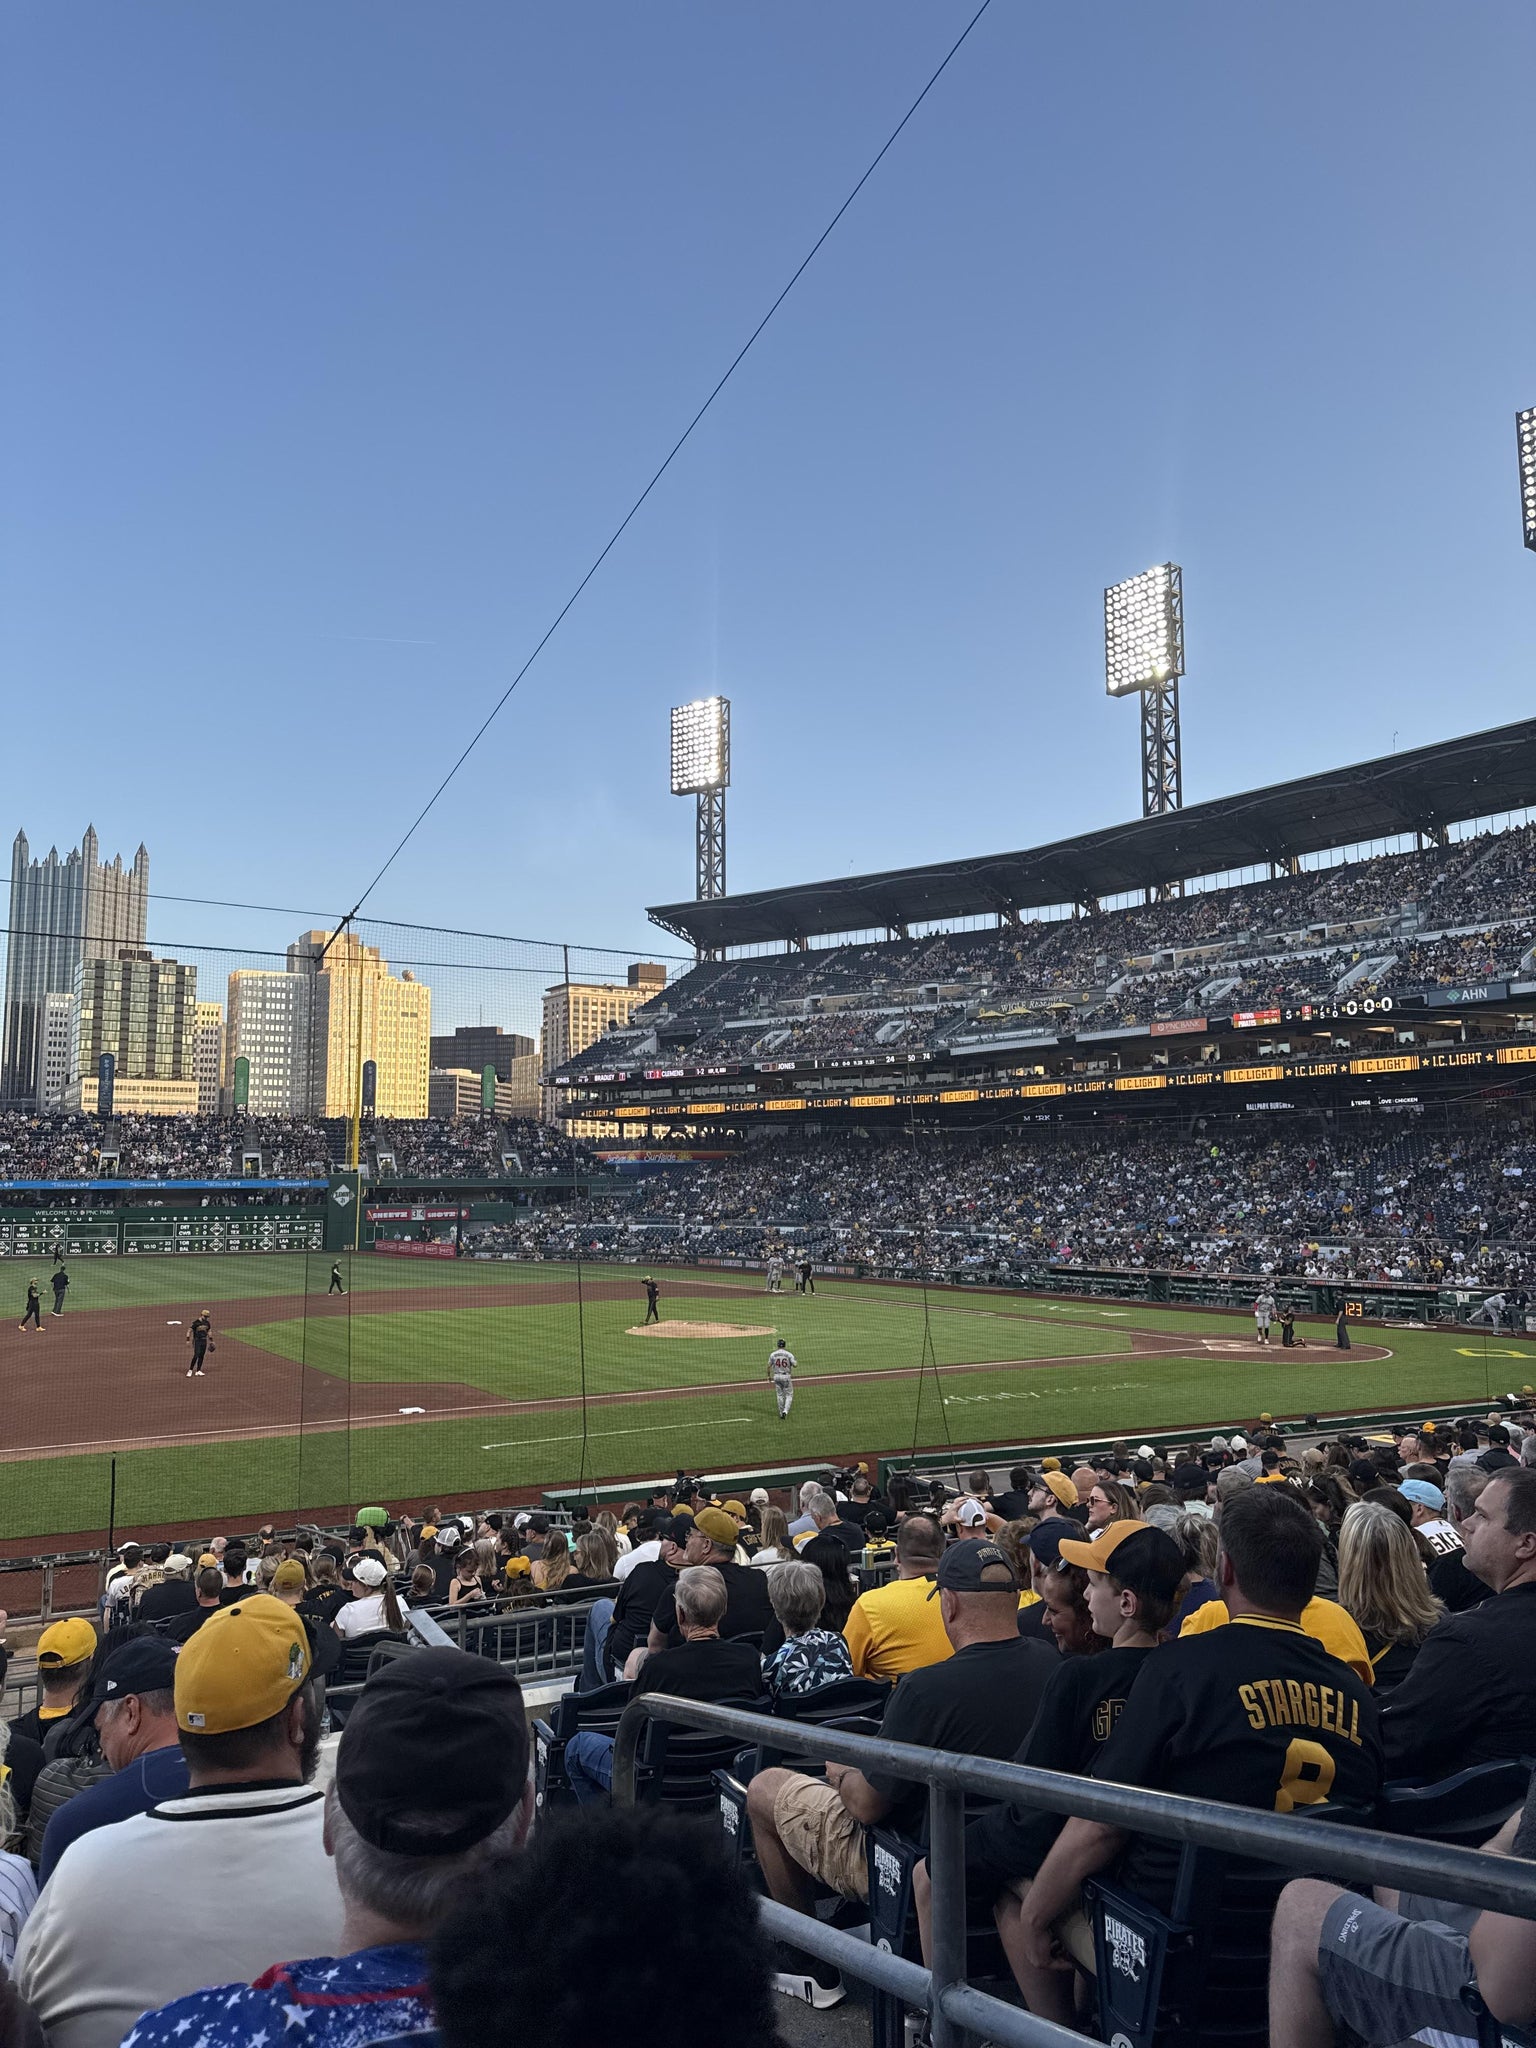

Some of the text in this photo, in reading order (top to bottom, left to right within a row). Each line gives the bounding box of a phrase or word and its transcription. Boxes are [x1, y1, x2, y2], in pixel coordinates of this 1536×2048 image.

[1462, 988, 1487, 1001] AHN
[1347, 1000, 1357, 1015] 0
[1364, 999, 1374, 1013] 0
[1381, 997, 1392, 1012] 0
[1332, 1010, 1338, 1018] 0
[1180, 1019, 1200, 1029] BANK
[885, 1055, 895, 1063] 24
[907, 1054, 916, 1062] 50
[1448, 1052, 1482, 1066] LIGHT
[778, 1061, 795, 1070] JONES
[1377, 1058, 1407, 1070] LIGHT
[661, 1069, 684, 1078] CLEMENS
[1247, 1069, 1273, 1080] LIGHT
[1309, 1064, 1337, 1075] LIGHT
[555, 1076, 570, 1084] JONES
[594, 1074, 615, 1082] BRADLEY
[1135, 1077, 1157, 1087] LIGHT
[1188, 1073, 1213, 1084] LIGHT
[1038, 1085, 1058, 1095] LIGHT
[1085, 1082, 1105, 1092] LIGHT
[956, 1091, 972, 1100] LIGHT
[995, 1088, 1013, 1098] LIGHT
[823, 1099, 842, 1107] LIGHT
[868, 1097, 887, 1105] LIGHT
[913, 1095, 933, 1104] LIGHT
[703, 1104, 719, 1113] LIGHT
[742, 1103, 758, 1111] LIGHT
[781, 1101, 800, 1109] LIGHT
[594, 1110, 609, 1118] LIGHT
[629, 1108, 645, 1116] LIGHT
[666, 1106, 681, 1115] LIGHT
[644, 1151, 676, 1162] Surfside
[35, 1209, 67, 1217] WELCOME
[976, 1547, 1004, 1562] PIRATES
[1238, 1678, 1363, 1747] STARGELL
[874, 1843, 901, 1884] PIRATES
[1338, 1908, 1363, 1943] SPALDING
[1104, 1912, 1146, 1967] PIRATES
